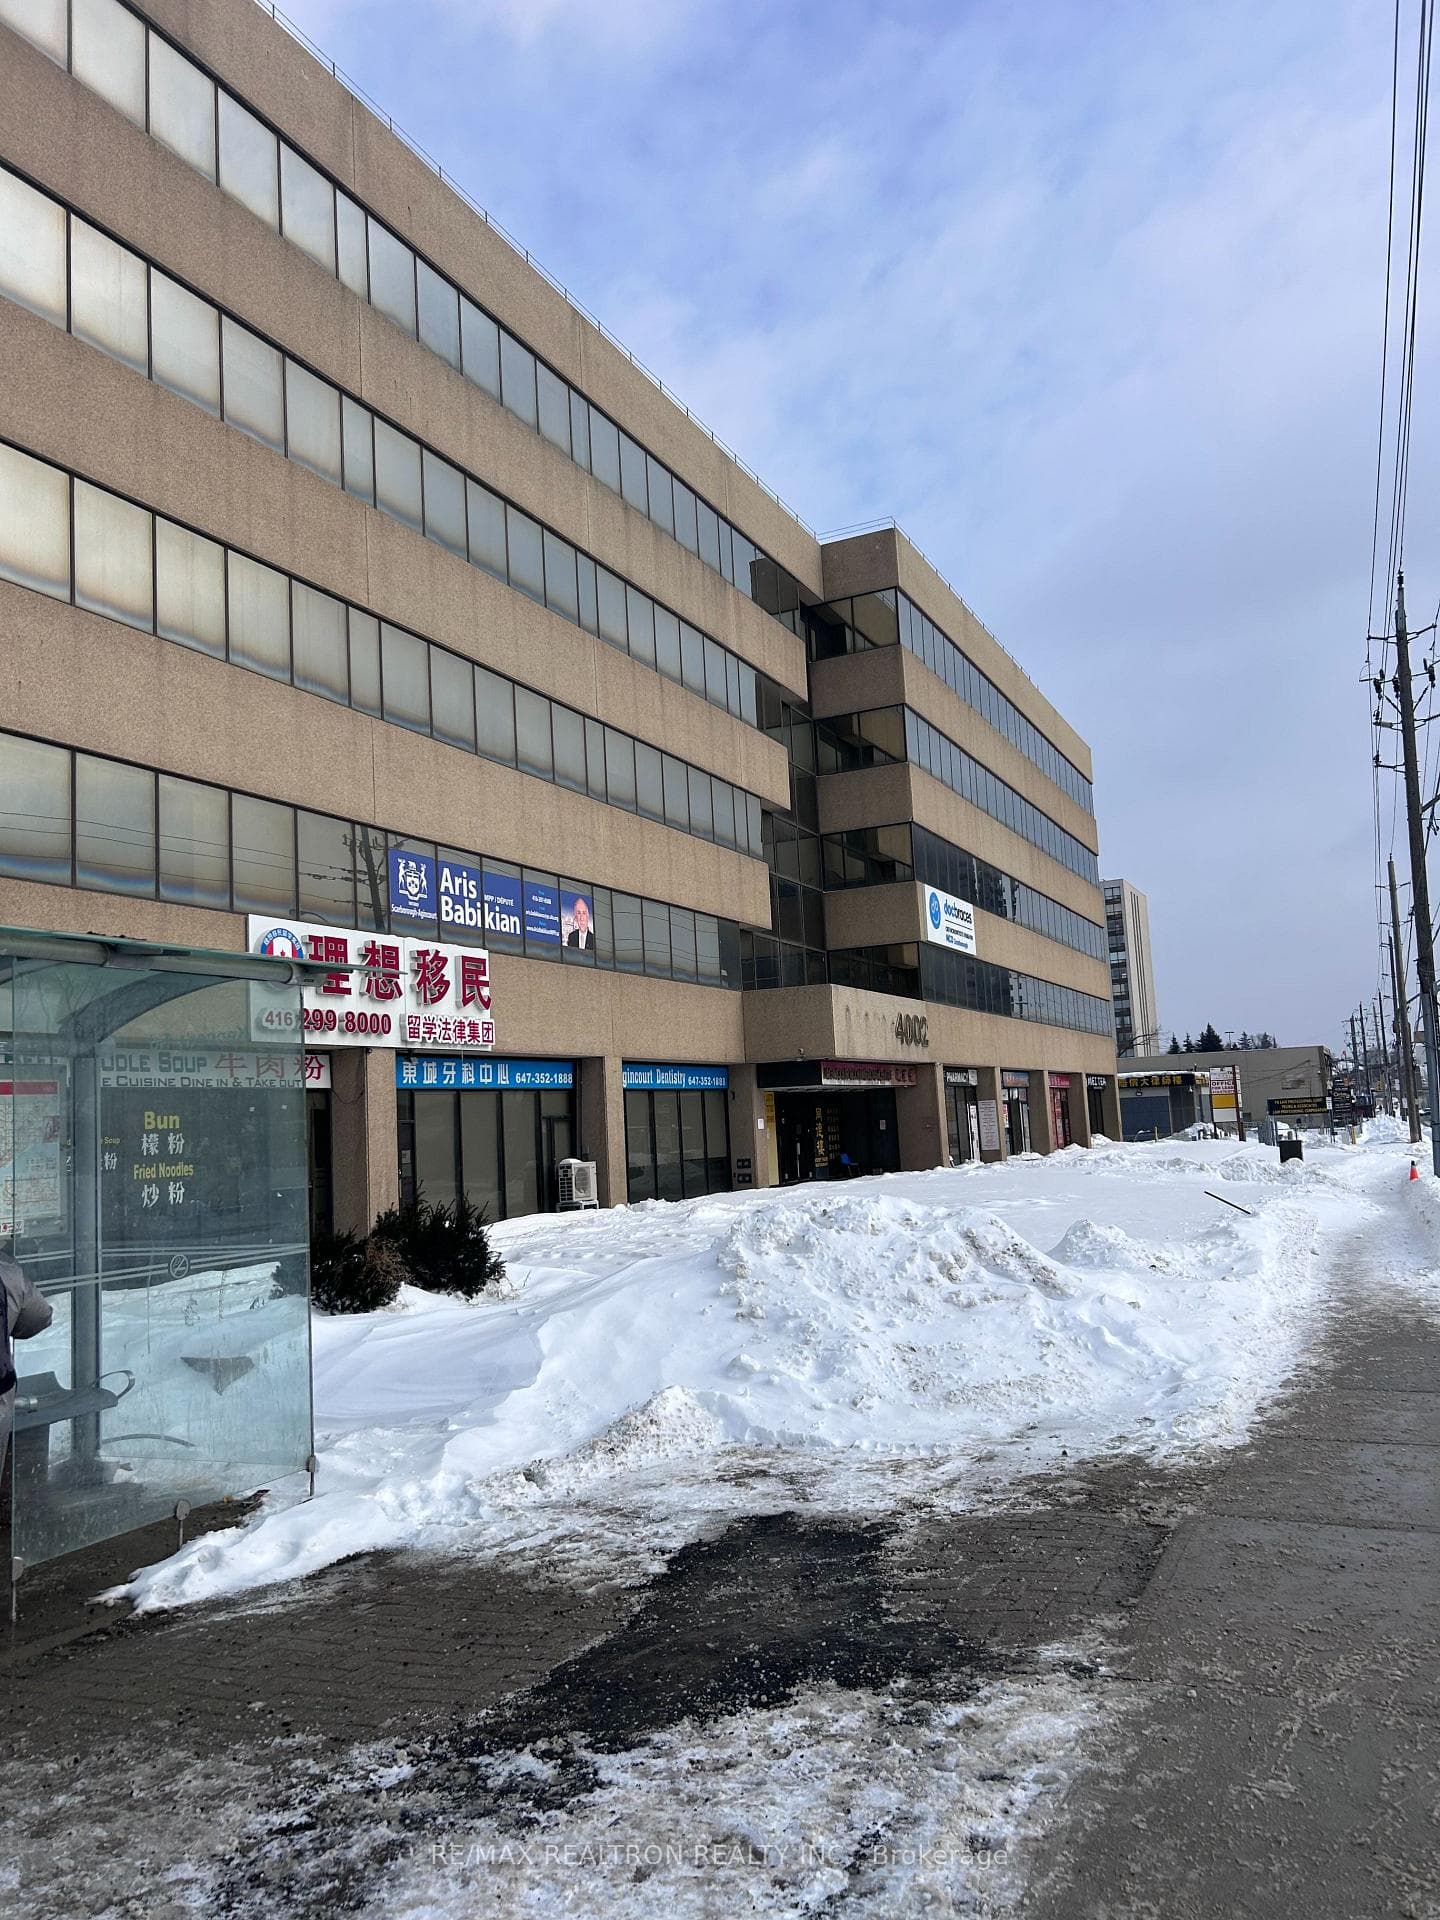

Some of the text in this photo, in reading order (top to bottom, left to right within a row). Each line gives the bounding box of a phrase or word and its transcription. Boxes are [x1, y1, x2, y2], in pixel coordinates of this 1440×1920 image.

[440, 867, 477, 899] Aris
[441, 895, 521, 935] Babikian
[305, 935, 492, 1010] 理想移民
[264, 1007, 392, 1035] 416 299 8000
[407, 1014, 495, 1044] 留学法律集团
[894, 1011, 929, 1048] 4002
[215, 1052, 325, 1081] 牛肉粉
[402, 1061, 510, 1084] 東城牙科中心
[515, 1072, 573, 1084] 647-352-1888
[656, 1068, 686, 1088] Dentistry
[116, 1075, 177, 1087] CUISINE
[180, 1076, 214, 1088] DINE
[232, 1077, 242, 1088] &
[245, 1077, 276, 1088] TAKE
[279, 1079, 302, 1088] OUT
[144, 1111, 180, 1130] Bun
[133, 1161, 194, 1180] Fried Noodles
[141, 1181, 185, 1208] 炒粉
